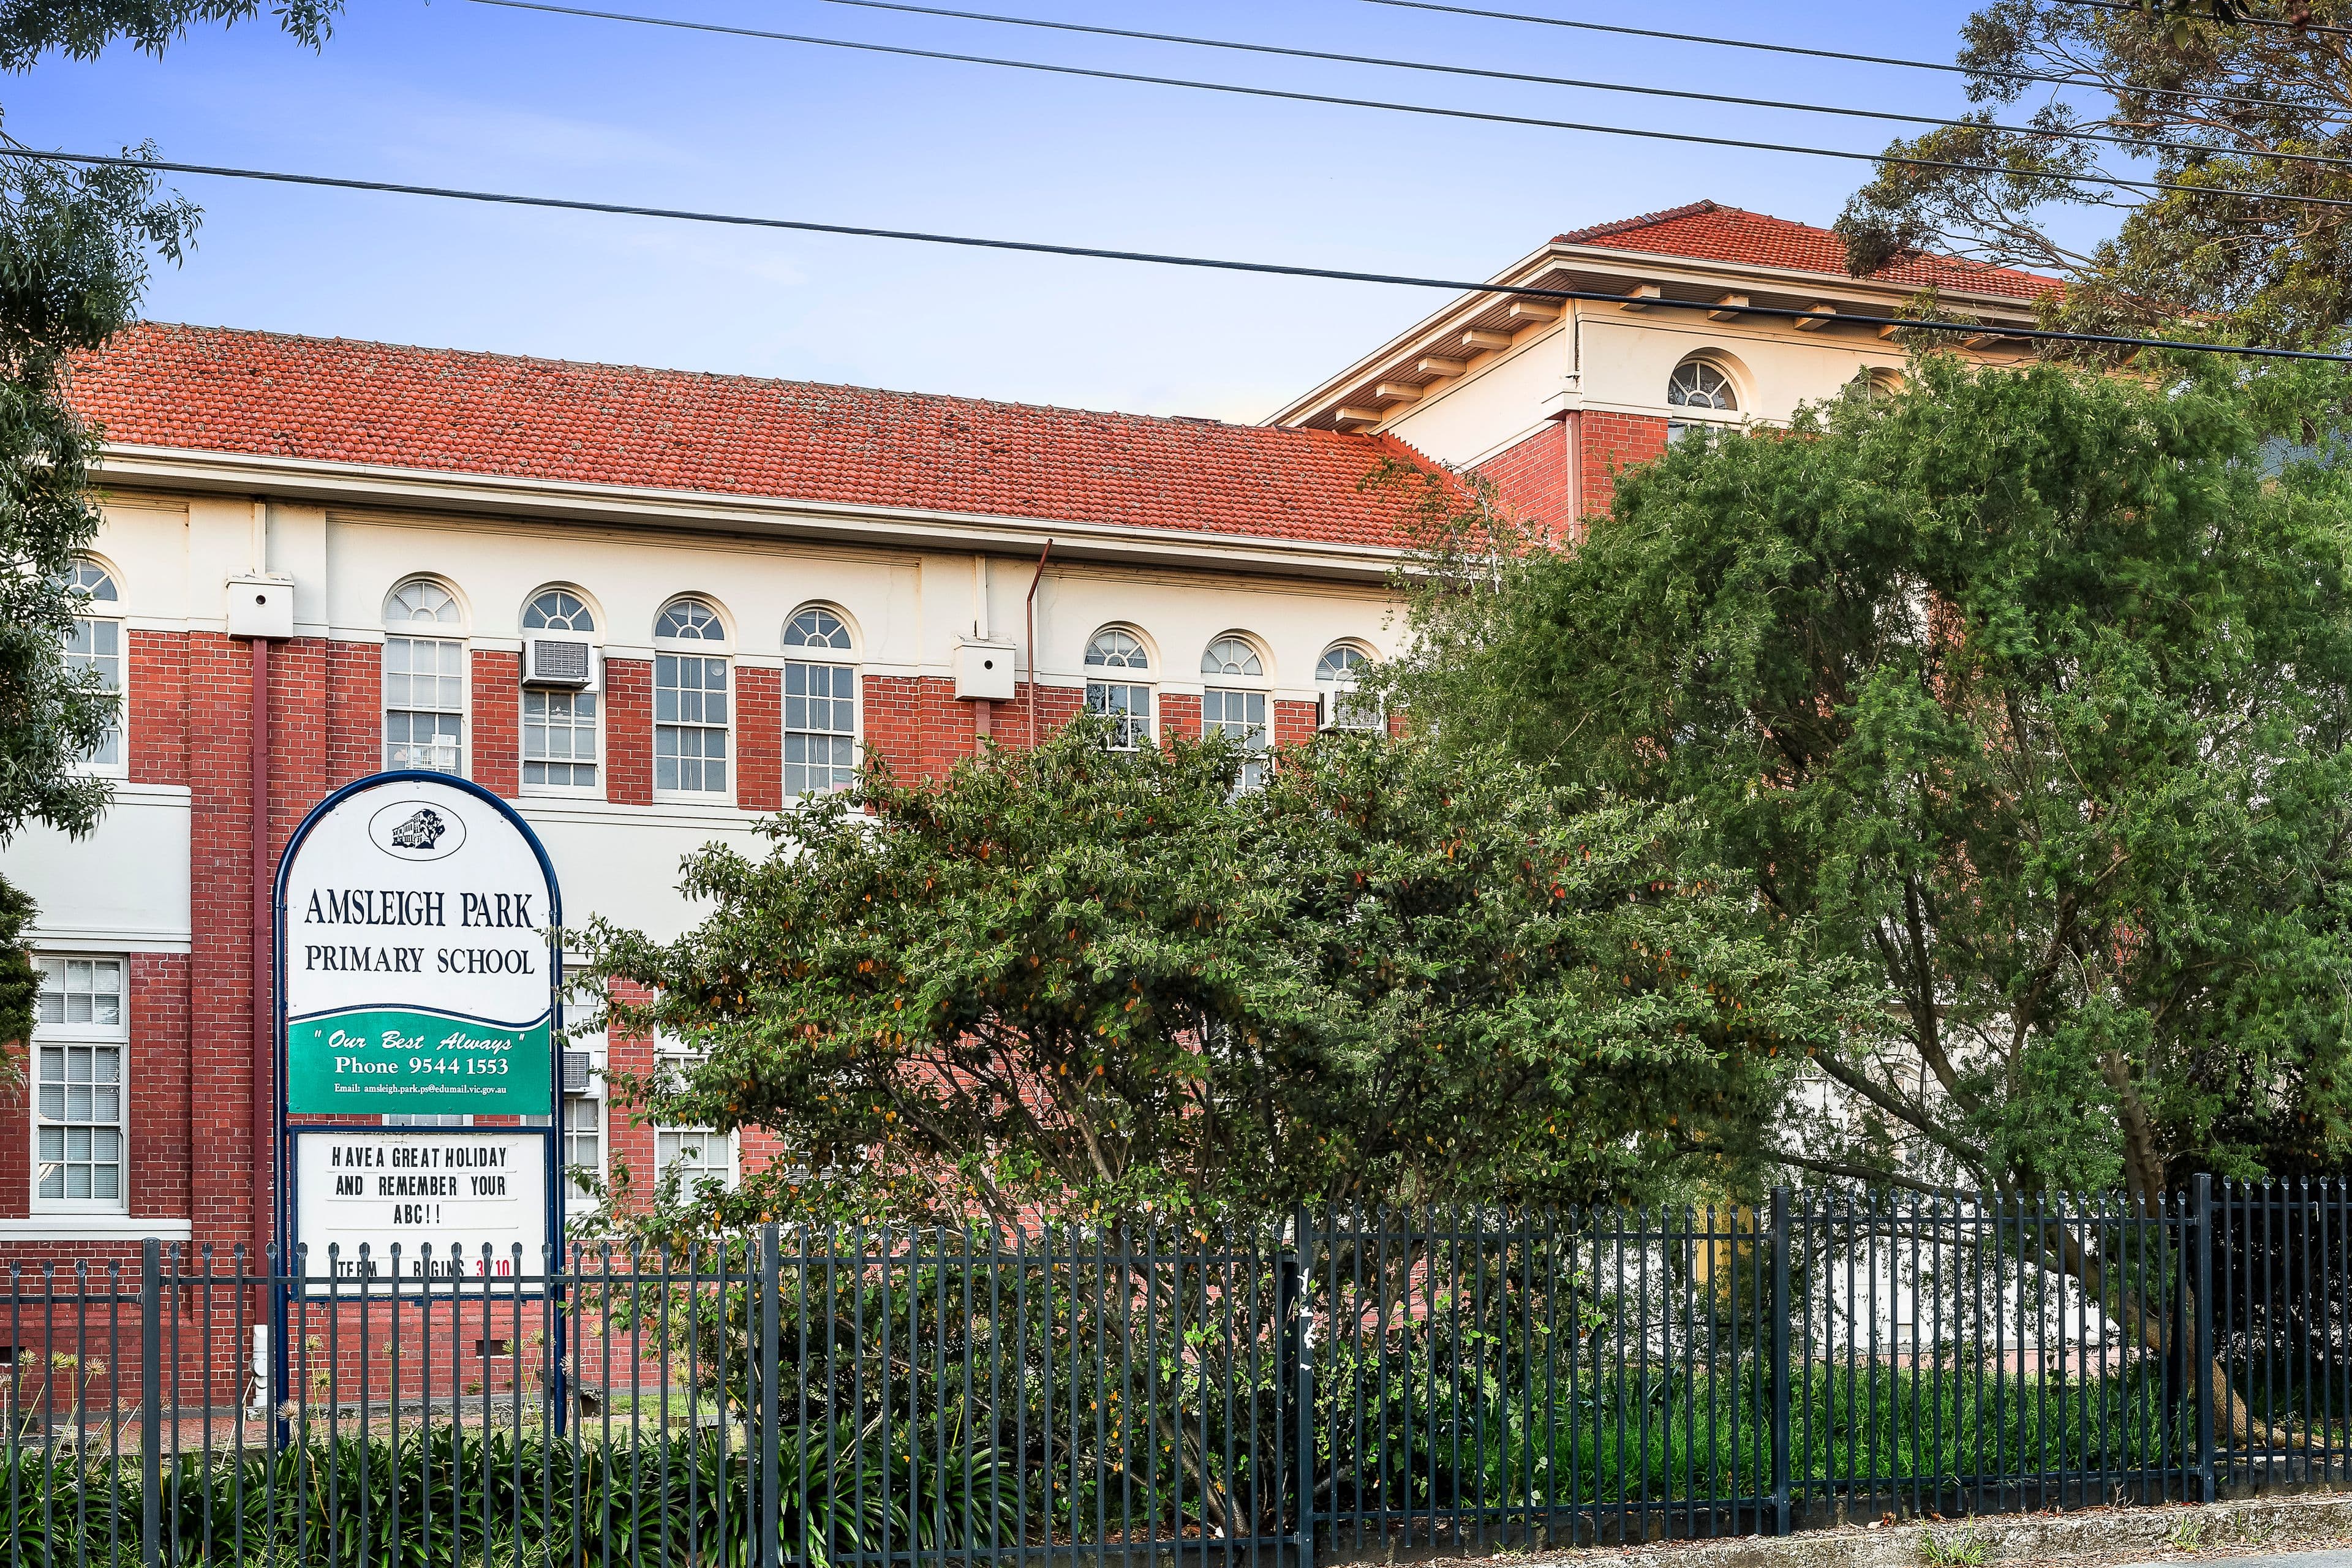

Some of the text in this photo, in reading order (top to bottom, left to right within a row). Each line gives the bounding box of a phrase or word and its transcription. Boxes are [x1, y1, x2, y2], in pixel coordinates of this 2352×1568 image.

[304, 888, 534, 928] AMSLEIGH PARK
[304, 945, 535, 974] PRIMARY SCHOOL
[381, 1030, 424, 1049] Best
[334, 1057, 509, 1074] Phone 9544 1553
[334, 1083, 507, 1095] Email: amsleigh.park.ps@edumail.vic.gov.au
[332, 1147, 507, 1167] HAVE A GREAT HOLIDAY
[336, 1175, 506, 1196] AND REMEMBER YOUR
[413, 1260, 464, 1277] BGINS
